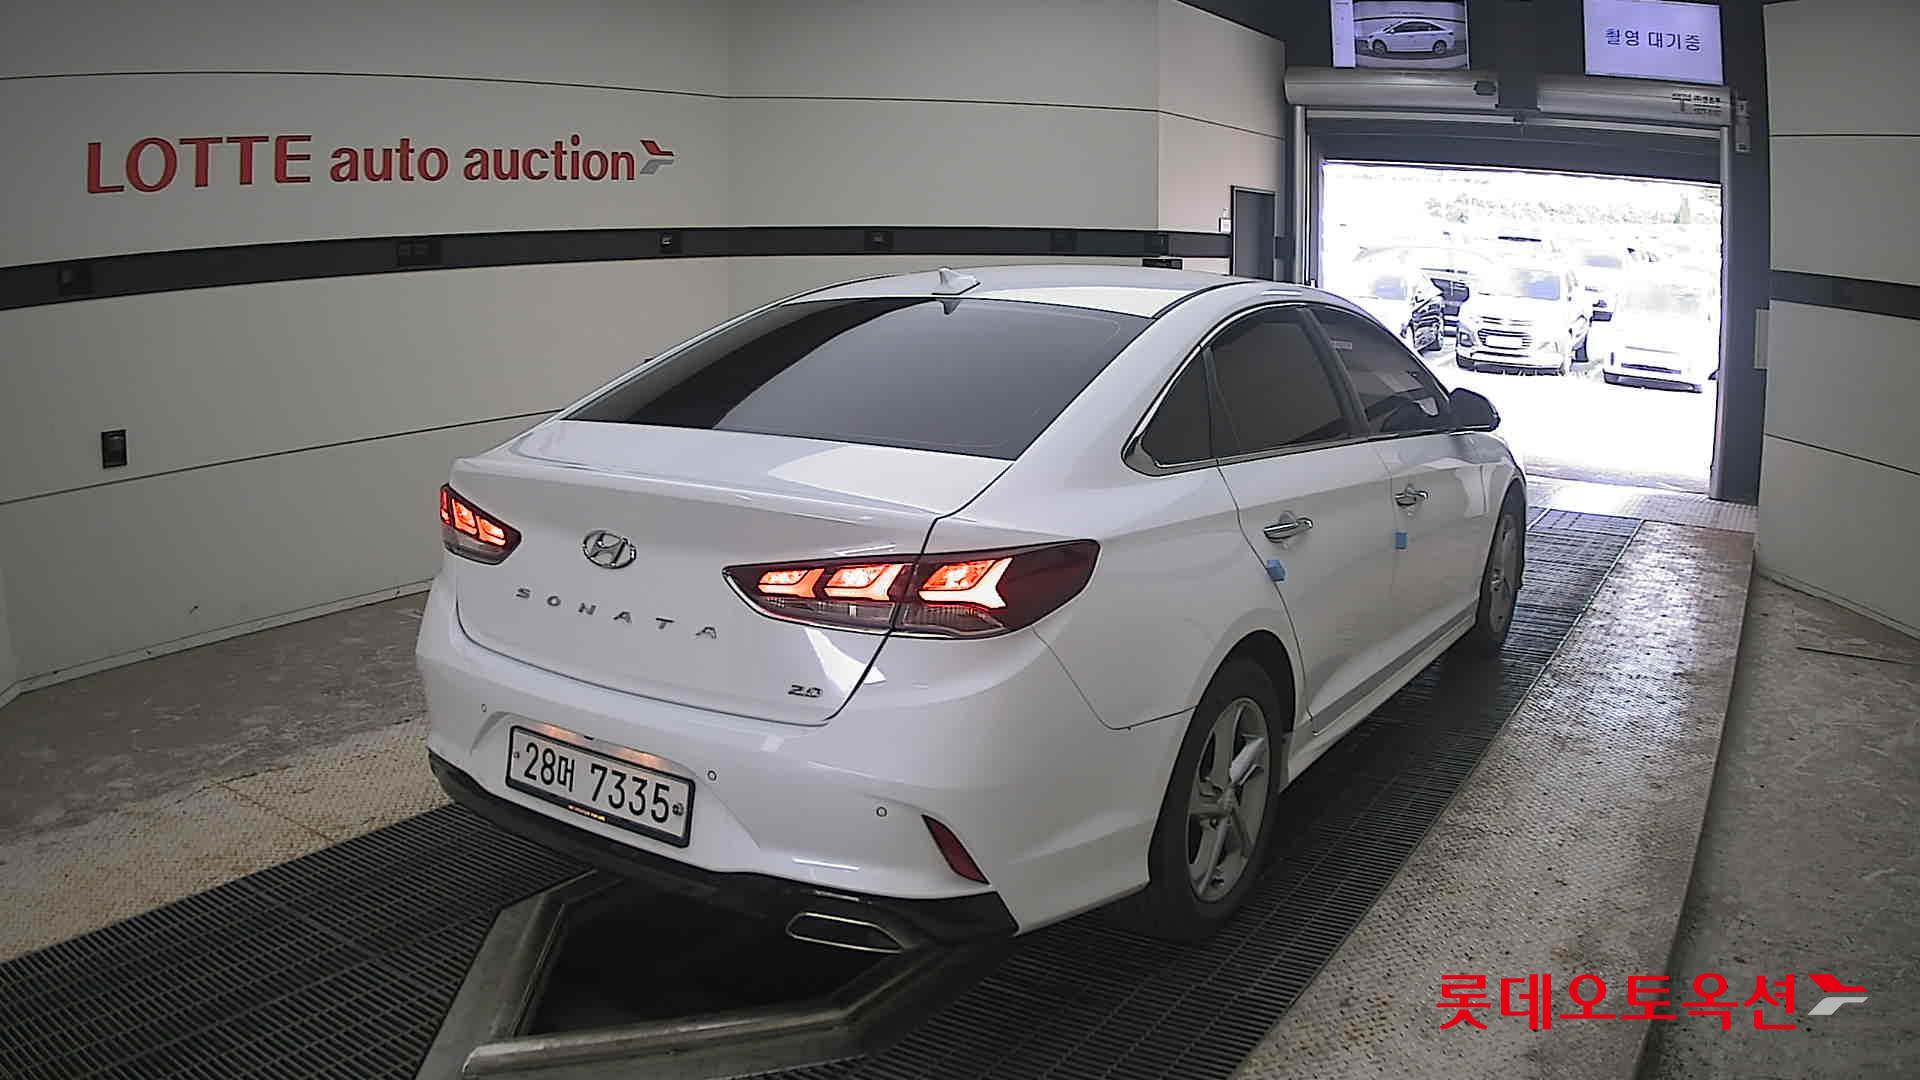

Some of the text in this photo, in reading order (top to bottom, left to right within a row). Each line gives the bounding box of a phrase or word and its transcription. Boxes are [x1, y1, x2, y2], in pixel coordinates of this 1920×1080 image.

[1647, 31, 1701, 52] 대기중
[87, 134, 635, 194] LOTTE auto auction
[515, 587, 718, 640] SONATA
[523, 742, 671, 823] 28머 7335
